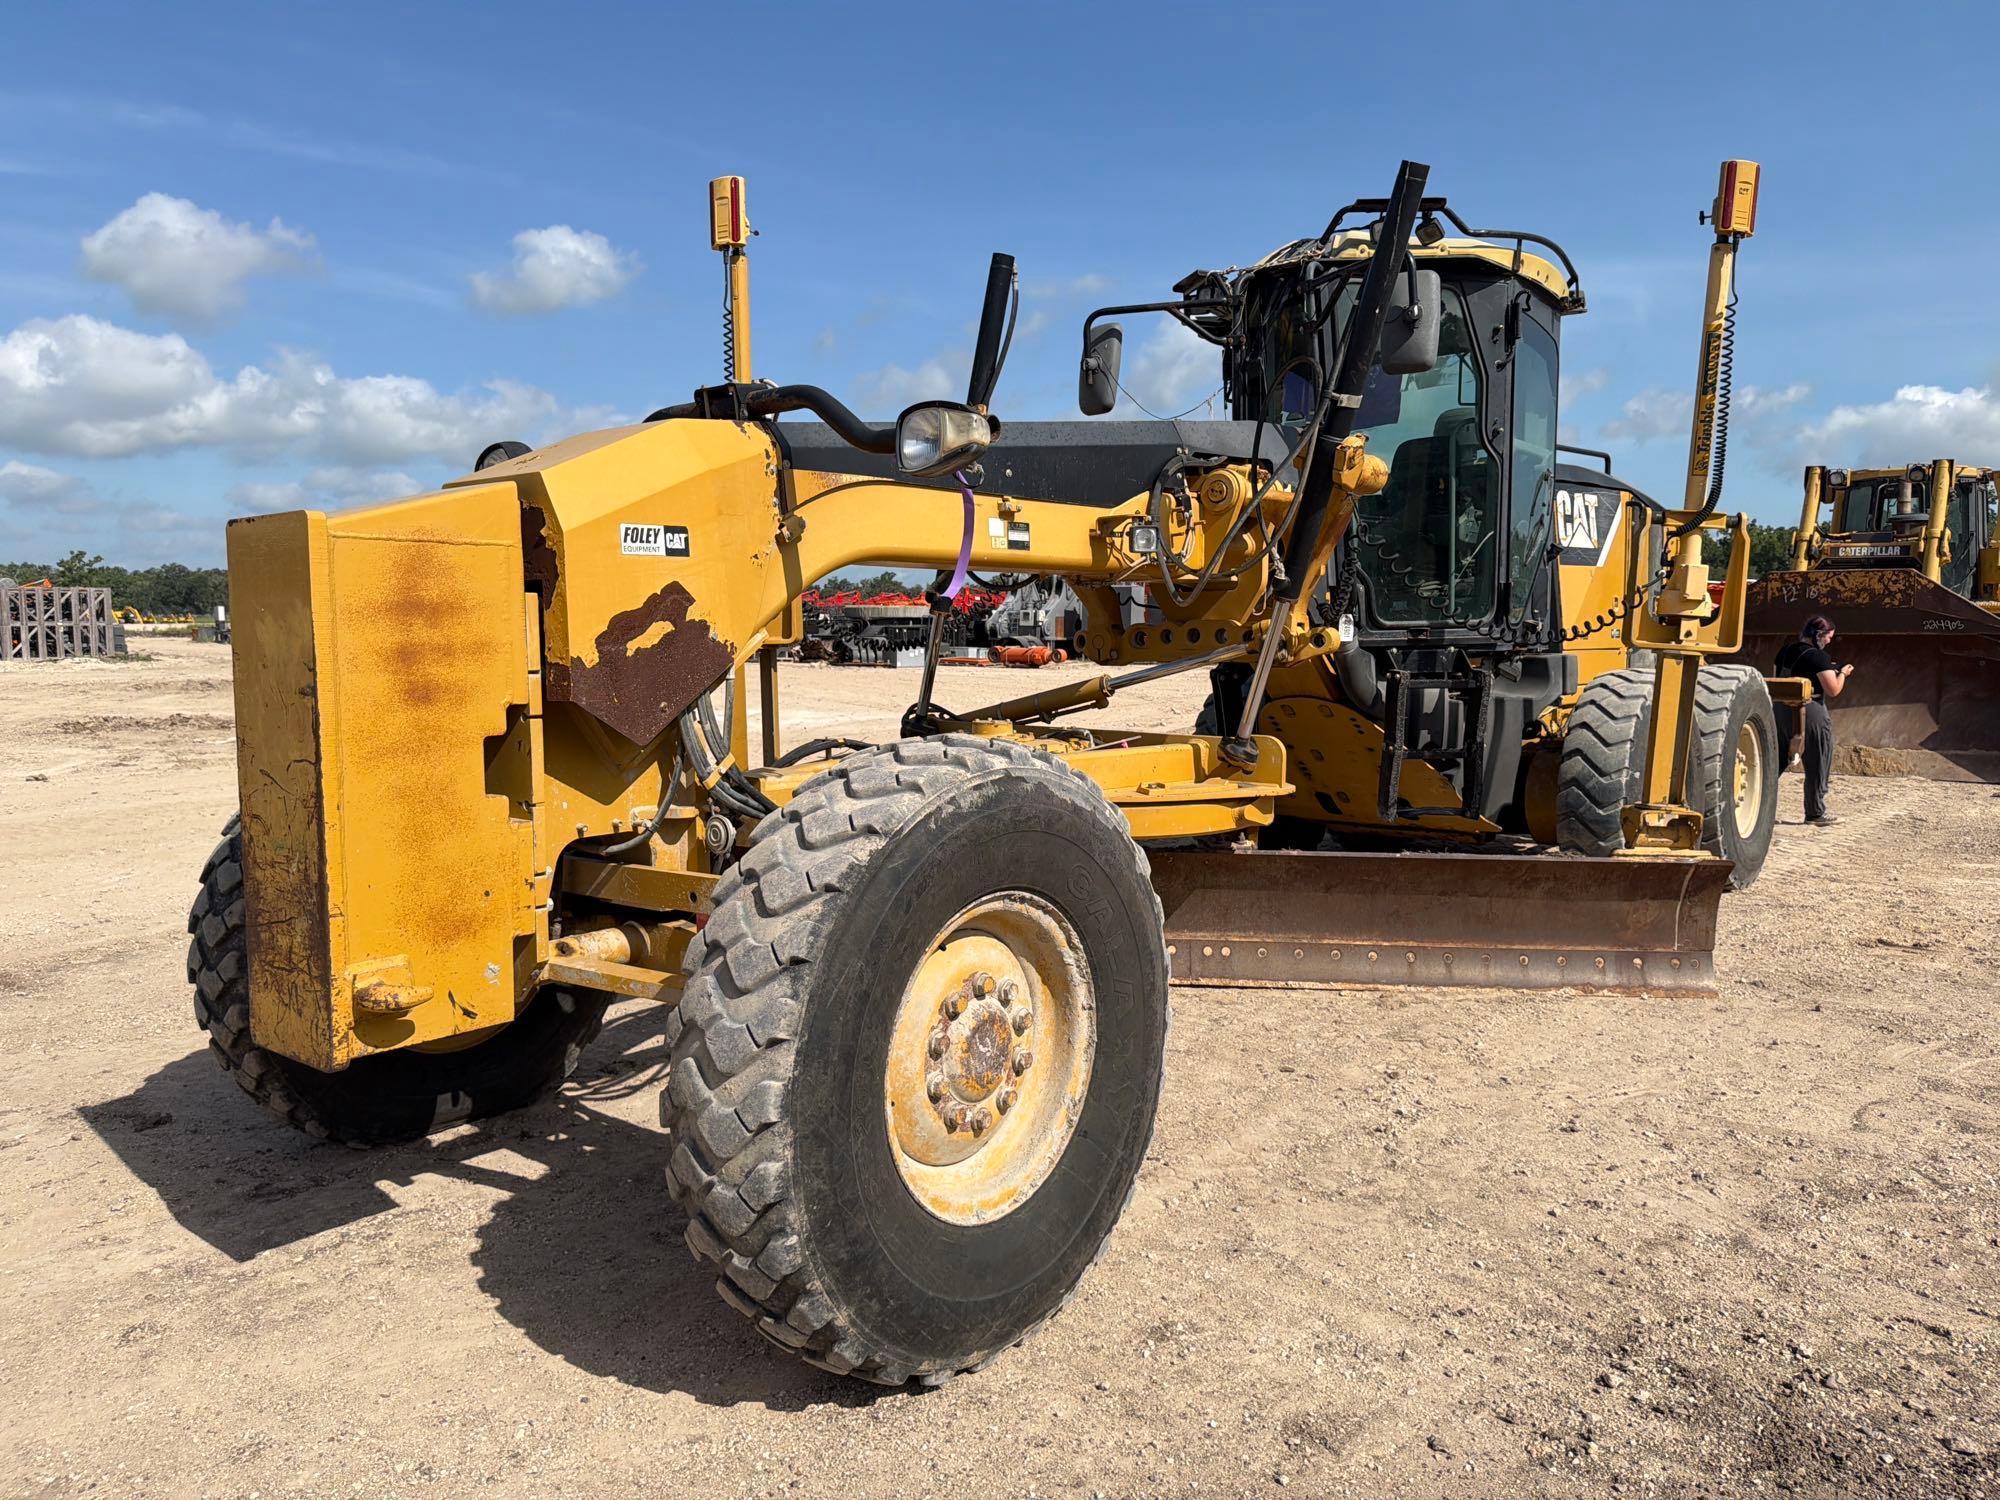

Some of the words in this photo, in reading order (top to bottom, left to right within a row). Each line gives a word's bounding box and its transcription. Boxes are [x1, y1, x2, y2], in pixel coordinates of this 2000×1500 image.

[1696, 402, 1715, 455] Trimble
[1556, 489, 1599, 549] CAT
[623, 526, 661, 545] FOLEY
[665, 532, 688, 549] CAT
[623, 545, 660, 553] EQUIPMENT
[1838, 545, 1901, 557] CATERPILLAR
